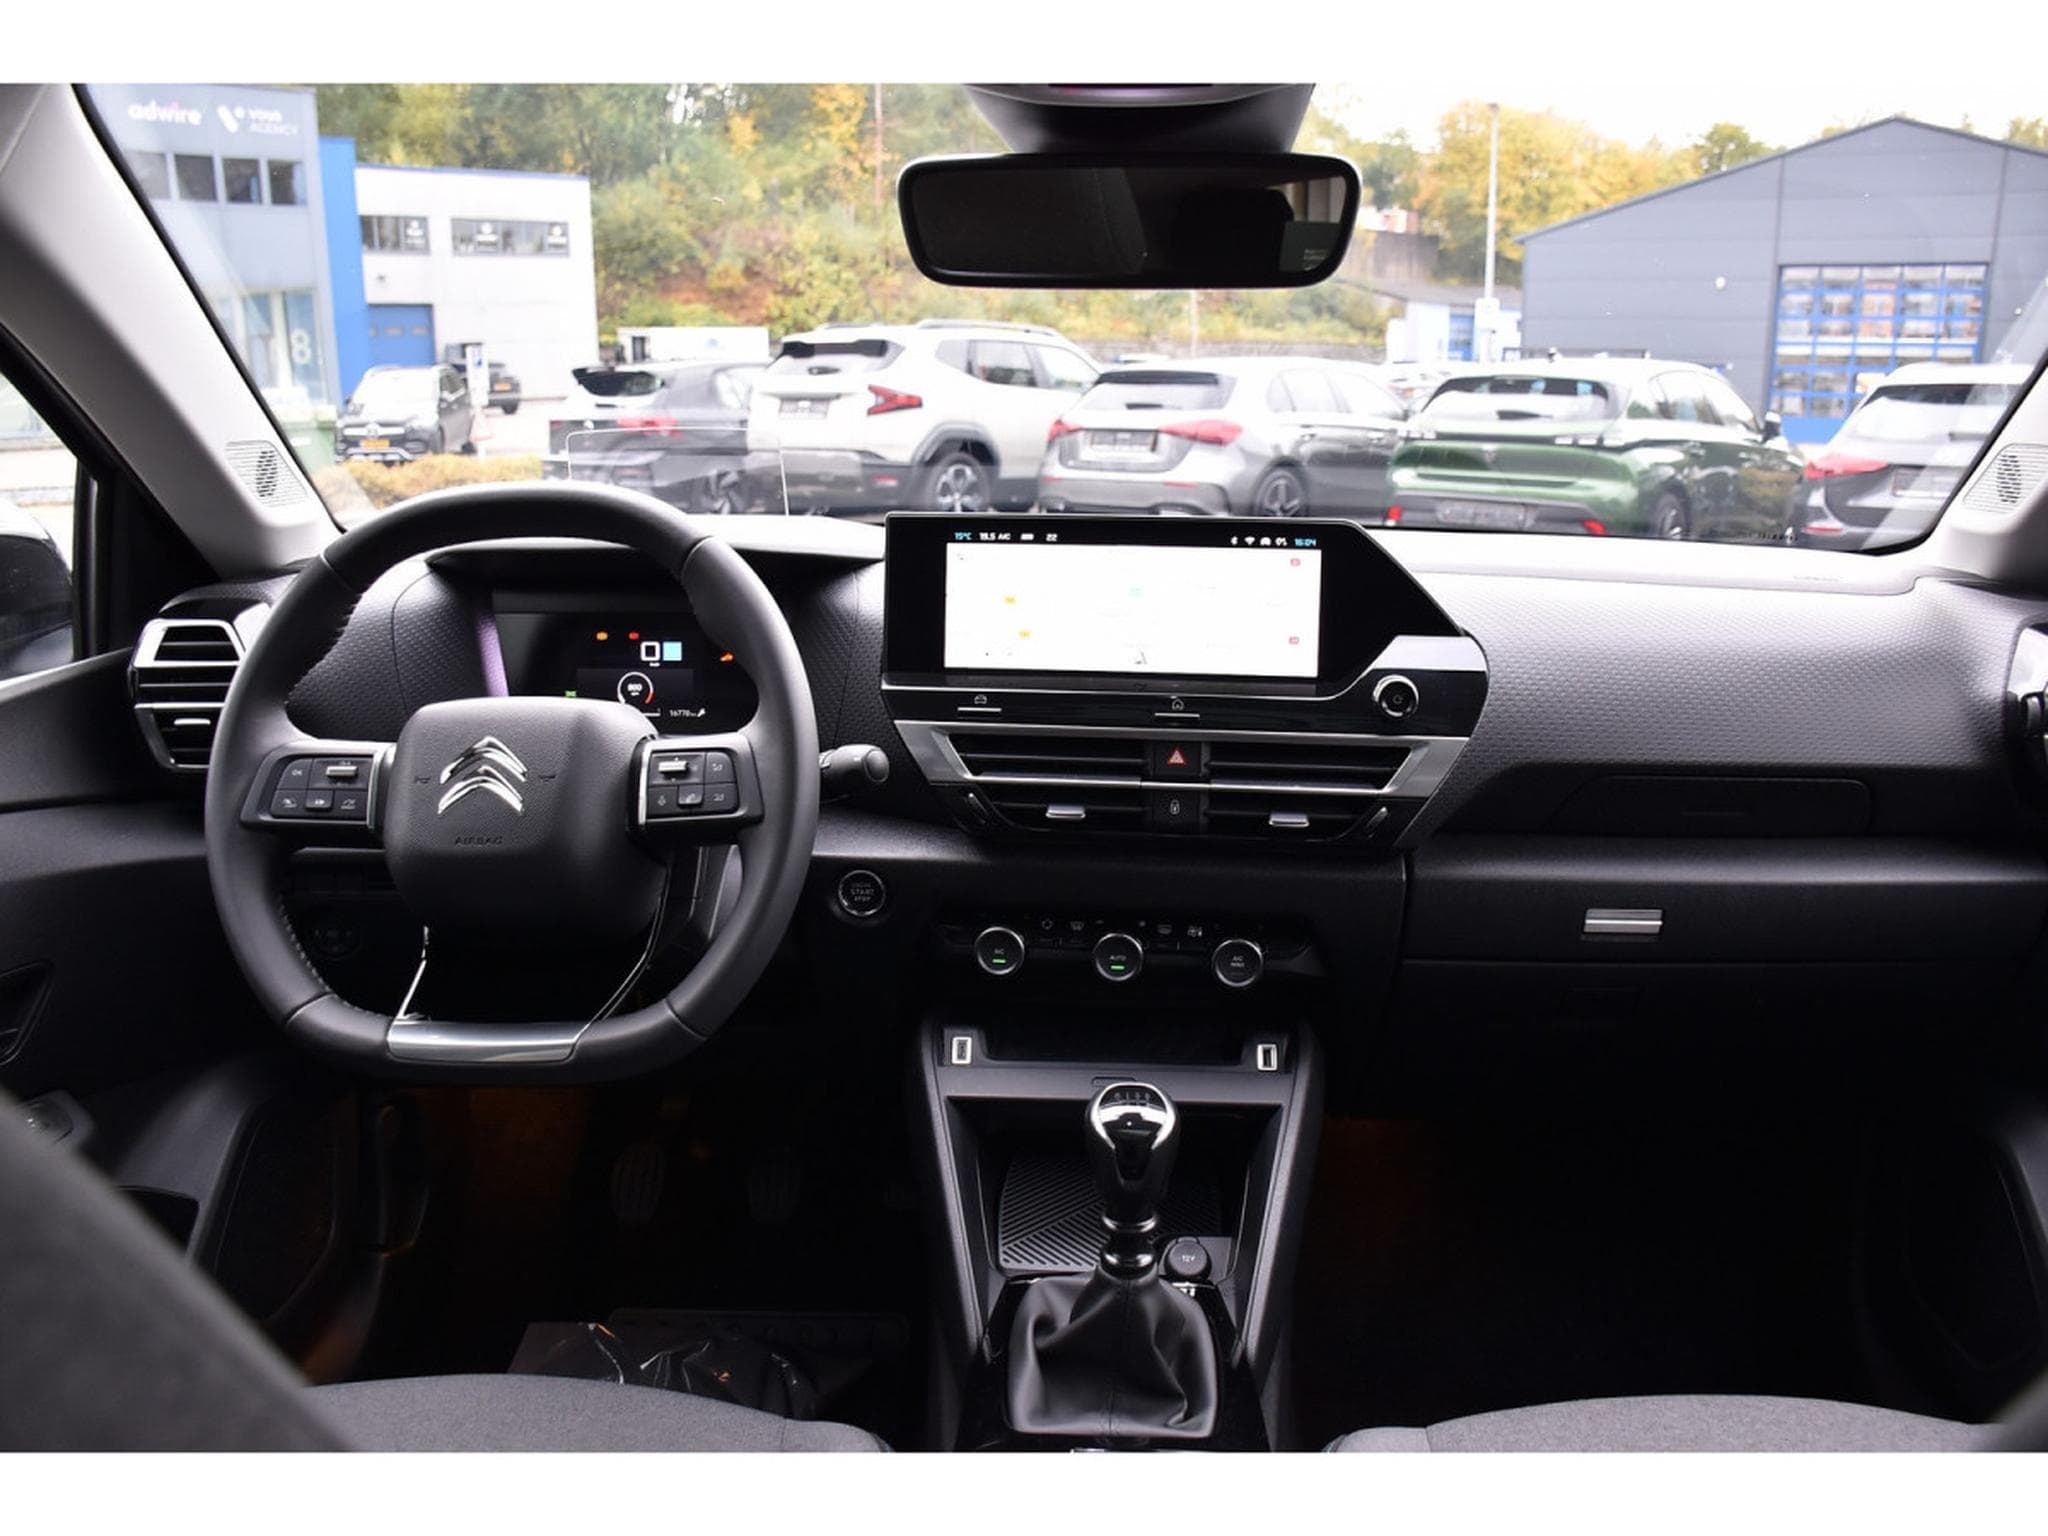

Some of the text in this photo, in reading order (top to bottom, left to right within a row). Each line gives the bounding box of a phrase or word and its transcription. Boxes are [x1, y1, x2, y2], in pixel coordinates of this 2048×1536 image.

[128, 100, 202, 125] adwire
[291, 328, 312, 364] 8
[454, 836, 503, 846] AIRBAG
